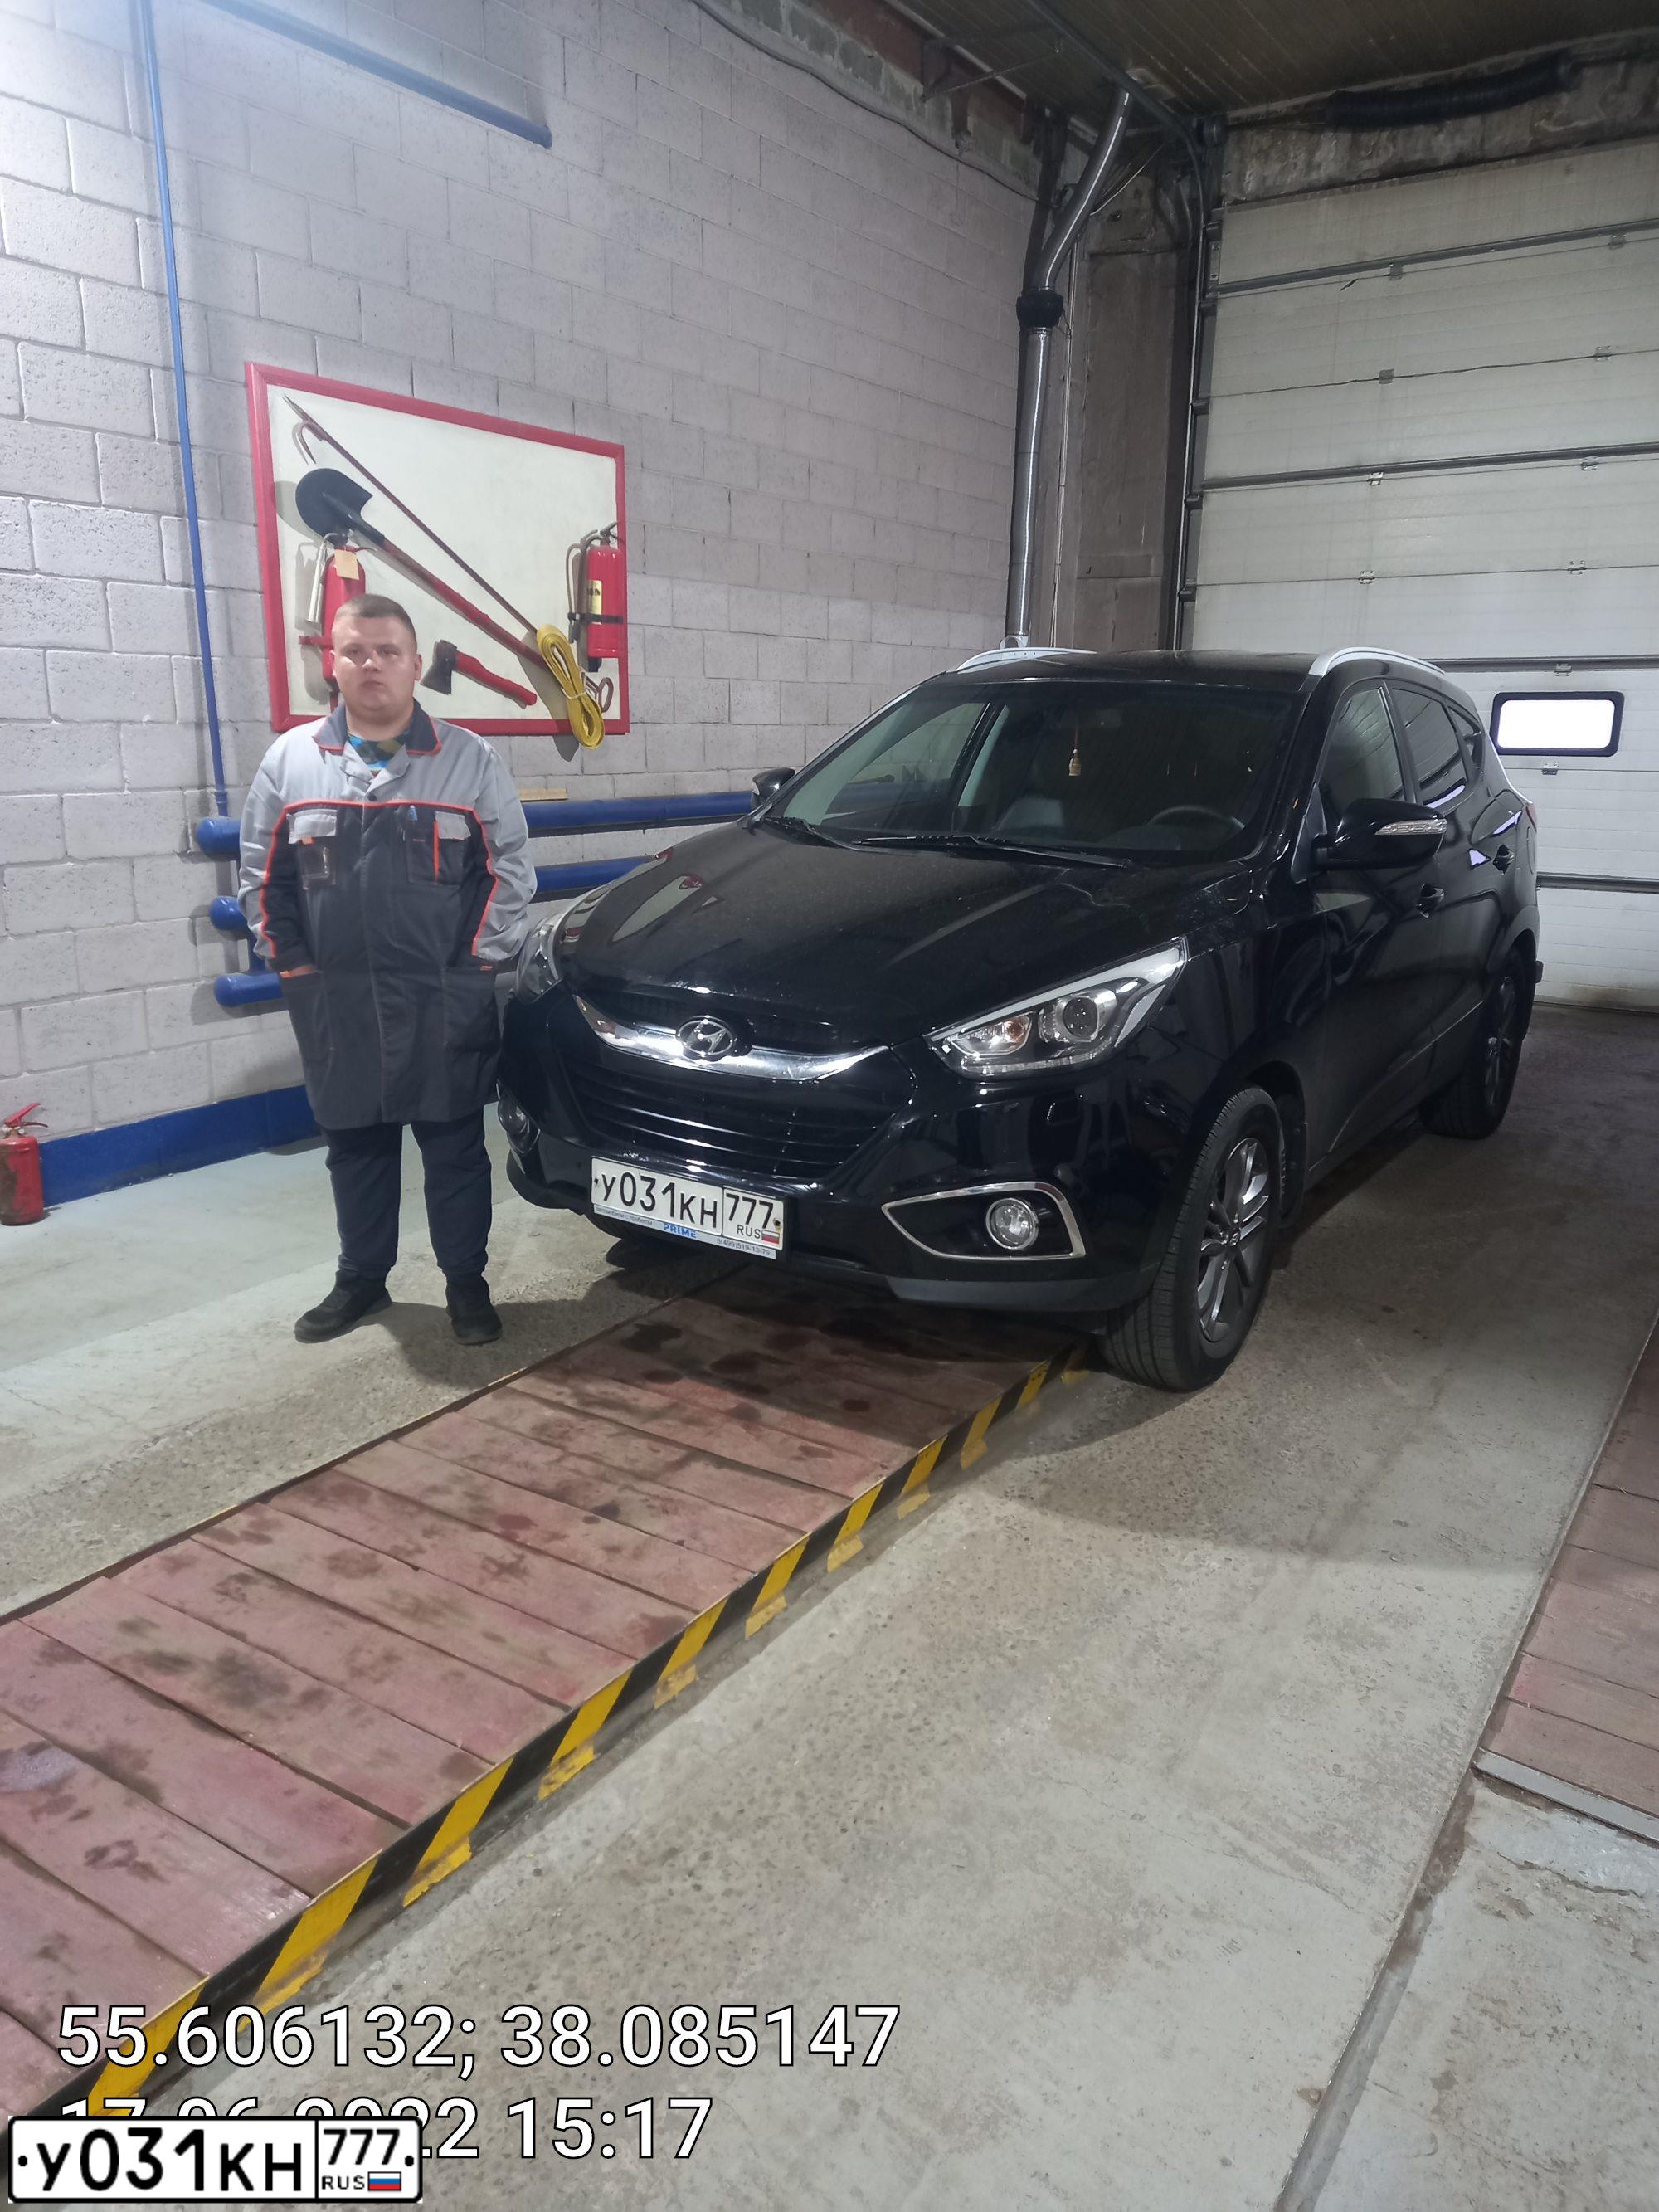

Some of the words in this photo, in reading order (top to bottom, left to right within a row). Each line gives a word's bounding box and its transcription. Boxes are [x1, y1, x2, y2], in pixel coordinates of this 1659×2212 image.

[601, 1172, 718, 1229] У031КН
[726, 1193, 774, 1230] 777
[664, 1223, 697, 1238] PRIME
[737, 1224, 761, 1240] RUS
